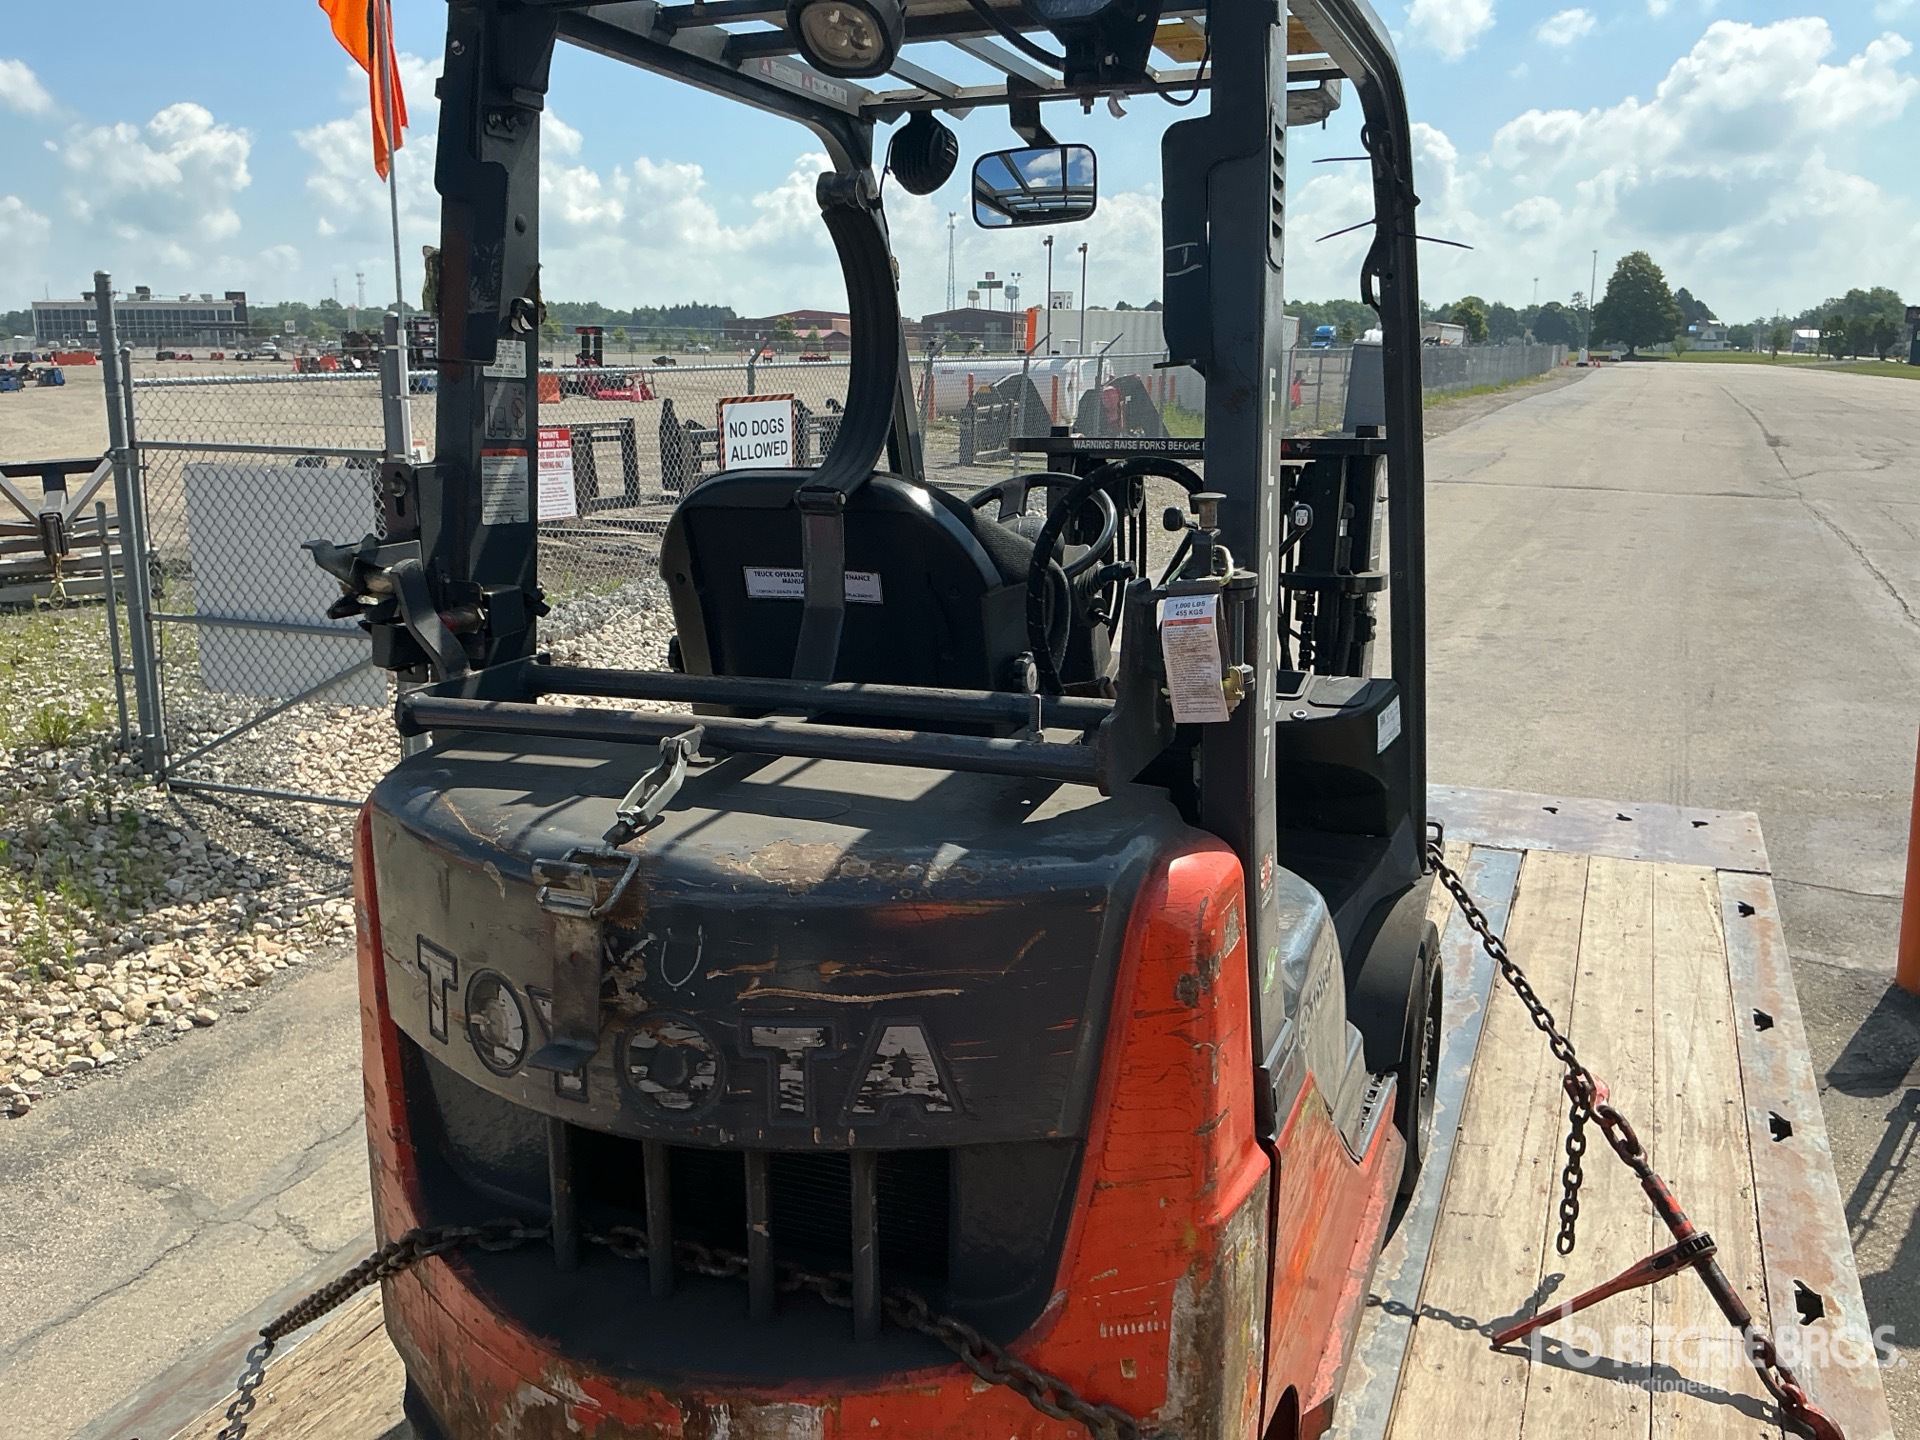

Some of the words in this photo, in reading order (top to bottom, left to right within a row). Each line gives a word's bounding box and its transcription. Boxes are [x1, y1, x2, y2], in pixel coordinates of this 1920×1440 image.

[729, 421, 747, 438] NO
[752, 417, 784, 436] DOGS
[731, 440, 788, 462] ALLOWED
[1073, 440, 1112, 450] WARNING:
[1114, 440, 1137, 450] RAISE
[1140, 440, 1167, 451] FORKS
[1168, 441, 1201, 451] BEFORE
[754, 570, 773, 578] TRUCK
[774, 571, 805, 579] OPERATIO
